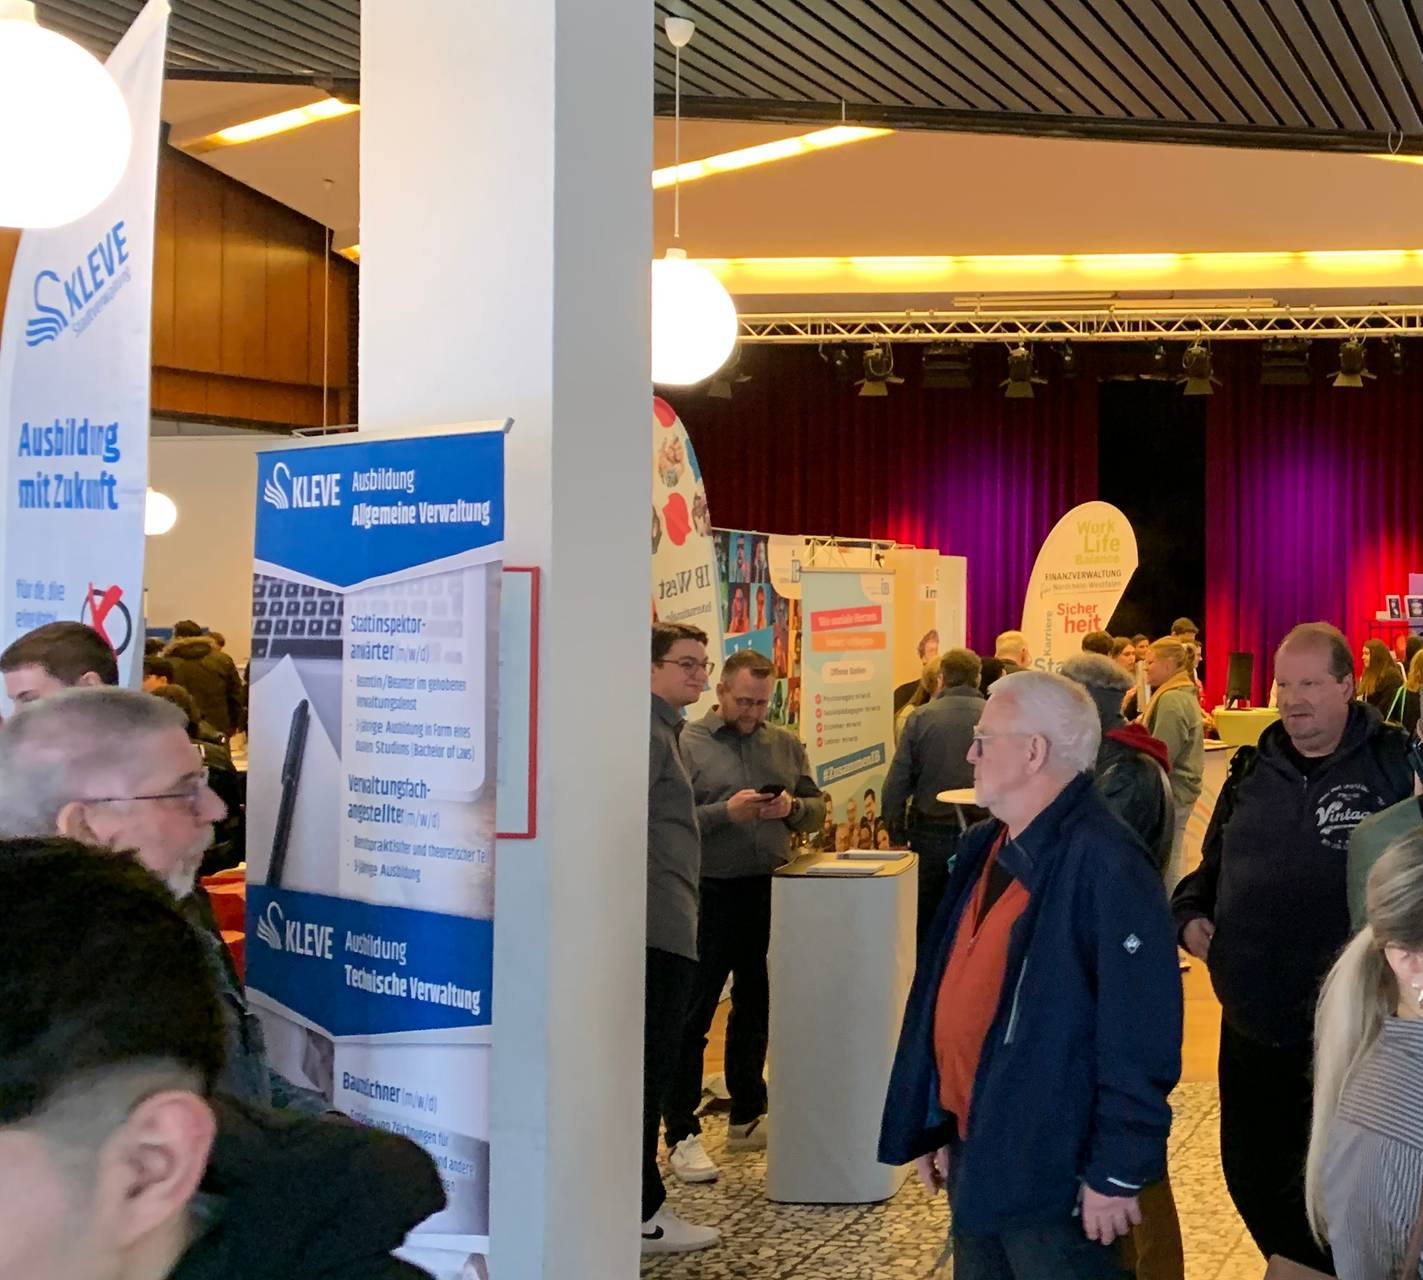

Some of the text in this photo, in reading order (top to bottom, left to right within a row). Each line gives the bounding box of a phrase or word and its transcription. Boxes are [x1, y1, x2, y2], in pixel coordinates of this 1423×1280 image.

[64, 220, 129, 317] KLEVE
[18, 418, 120, 463] Ausbildung
[18, 470, 119, 510] mit Zukunft
[292, 473, 341, 508] KLEVE
[352, 468, 415, 494] Ausbildung
[352, 499, 490, 529] Allgemeine Verwaltung
[1076, 518, 1116, 535] Work
[1084, 534, 1121, 553] Life
[1045, 569, 1122, 581] FINANZVERWALTUNG
[1057, 602, 1098, 616] Sicher
[1064, 614, 1102, 634] heit
[1315, 801, 1371, 826] Vinta
[285, 919, 333, 960] KLEVE
[345, 930, 407, 966] Ausbildung
[344, 963, 481, 1016] Technische Verwaltung
